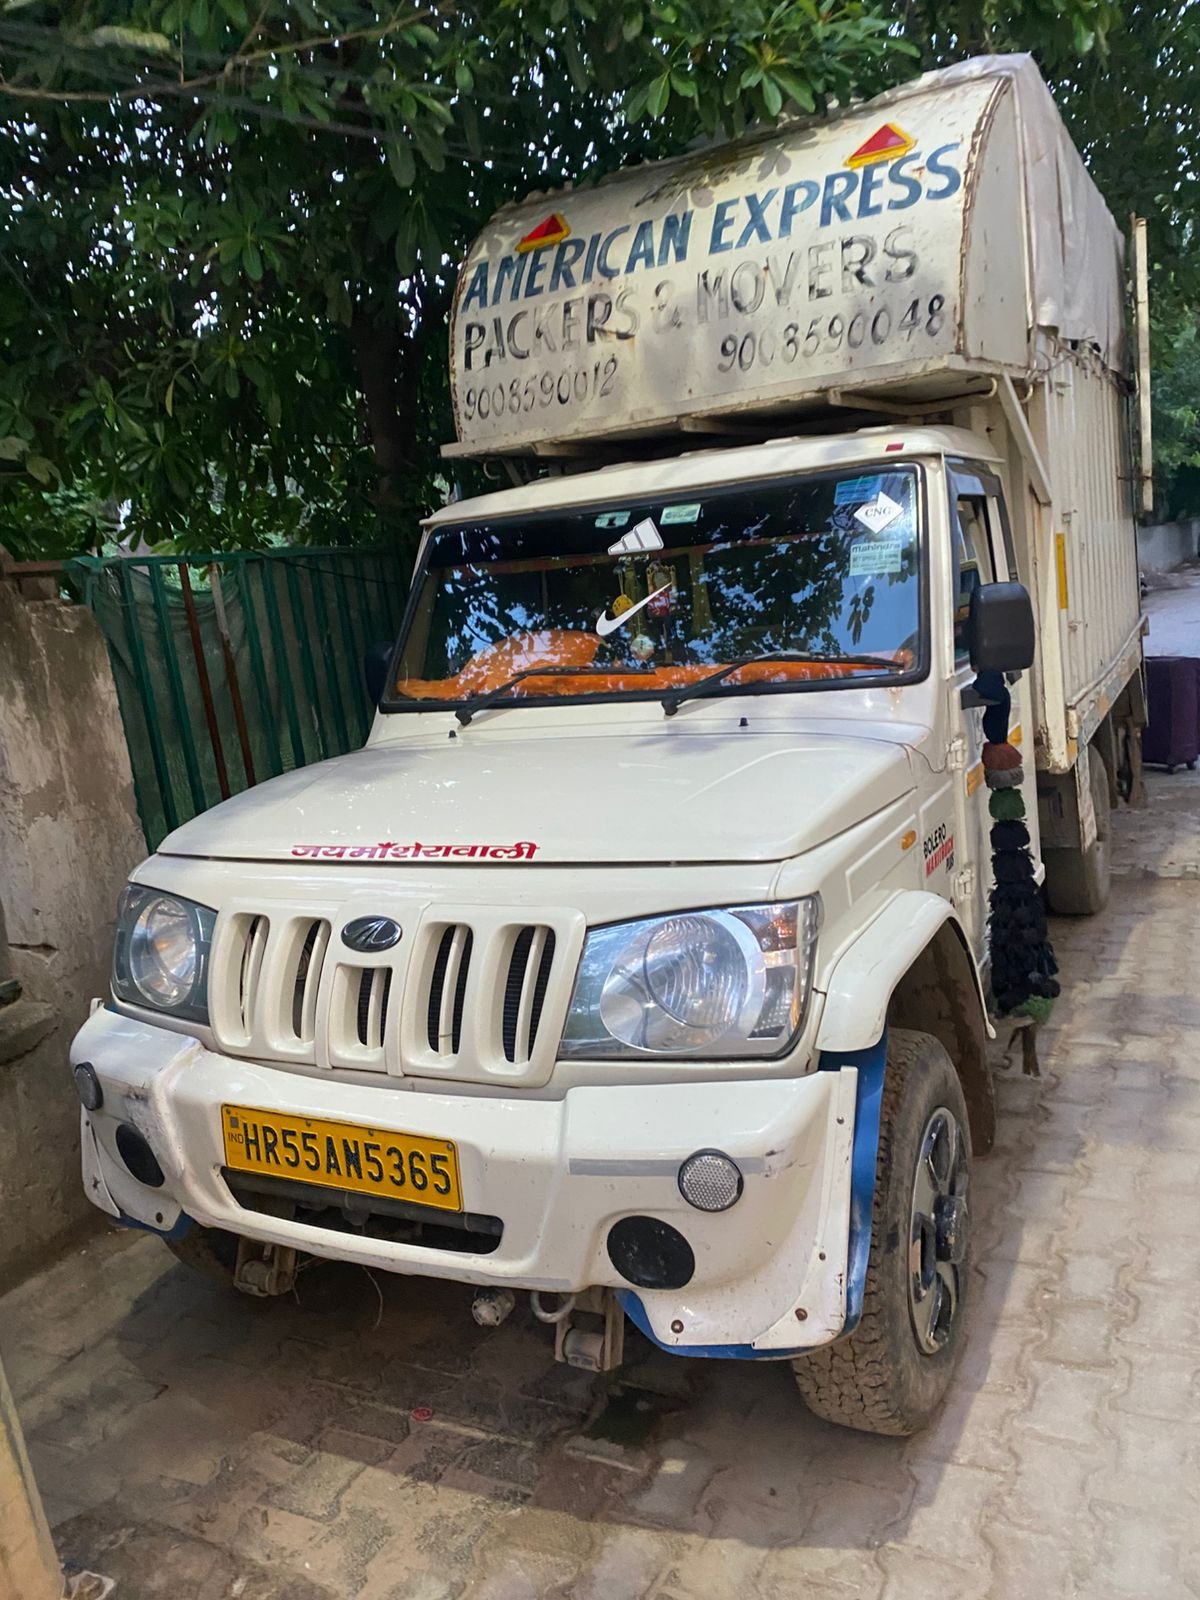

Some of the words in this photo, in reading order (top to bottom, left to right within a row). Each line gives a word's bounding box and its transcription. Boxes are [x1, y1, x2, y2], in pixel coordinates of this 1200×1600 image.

[461, 209, 694, 313] AMERICAN
[708, 142, 961, 254] EXPRESS
[464, 288, 641, 372] PACKERS
[697, 225, 919, 325] MOVERS
[865, 506, 891, 517] CNG
[852, 543, 901, 553] mahindra
[924, 823, 946, 858] BOLERO
[227, 1132, 244, 1145] IND
[243, 1121, 452, 1195] HR55AN5365
